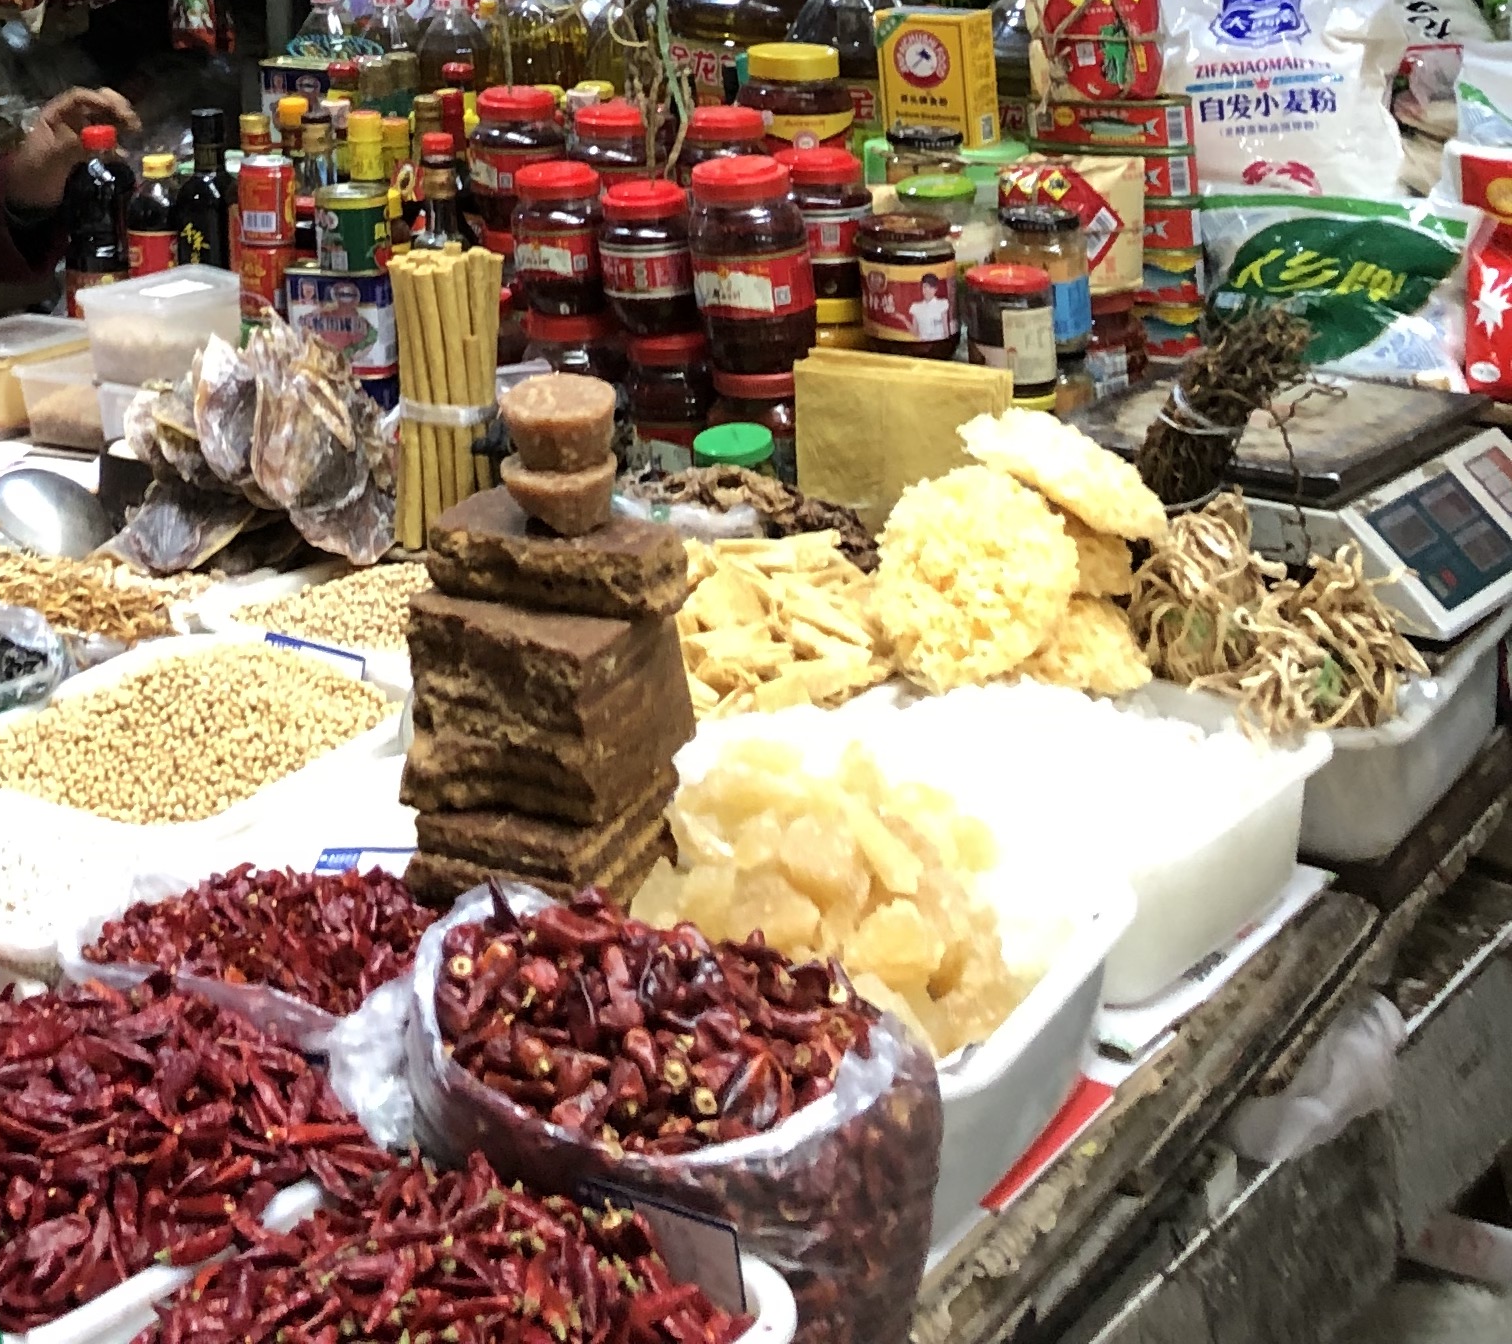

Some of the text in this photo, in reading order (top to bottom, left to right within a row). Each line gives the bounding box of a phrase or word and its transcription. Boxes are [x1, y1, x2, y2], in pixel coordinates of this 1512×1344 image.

[1199, 86, 1337, 124] 自发小麦粉
